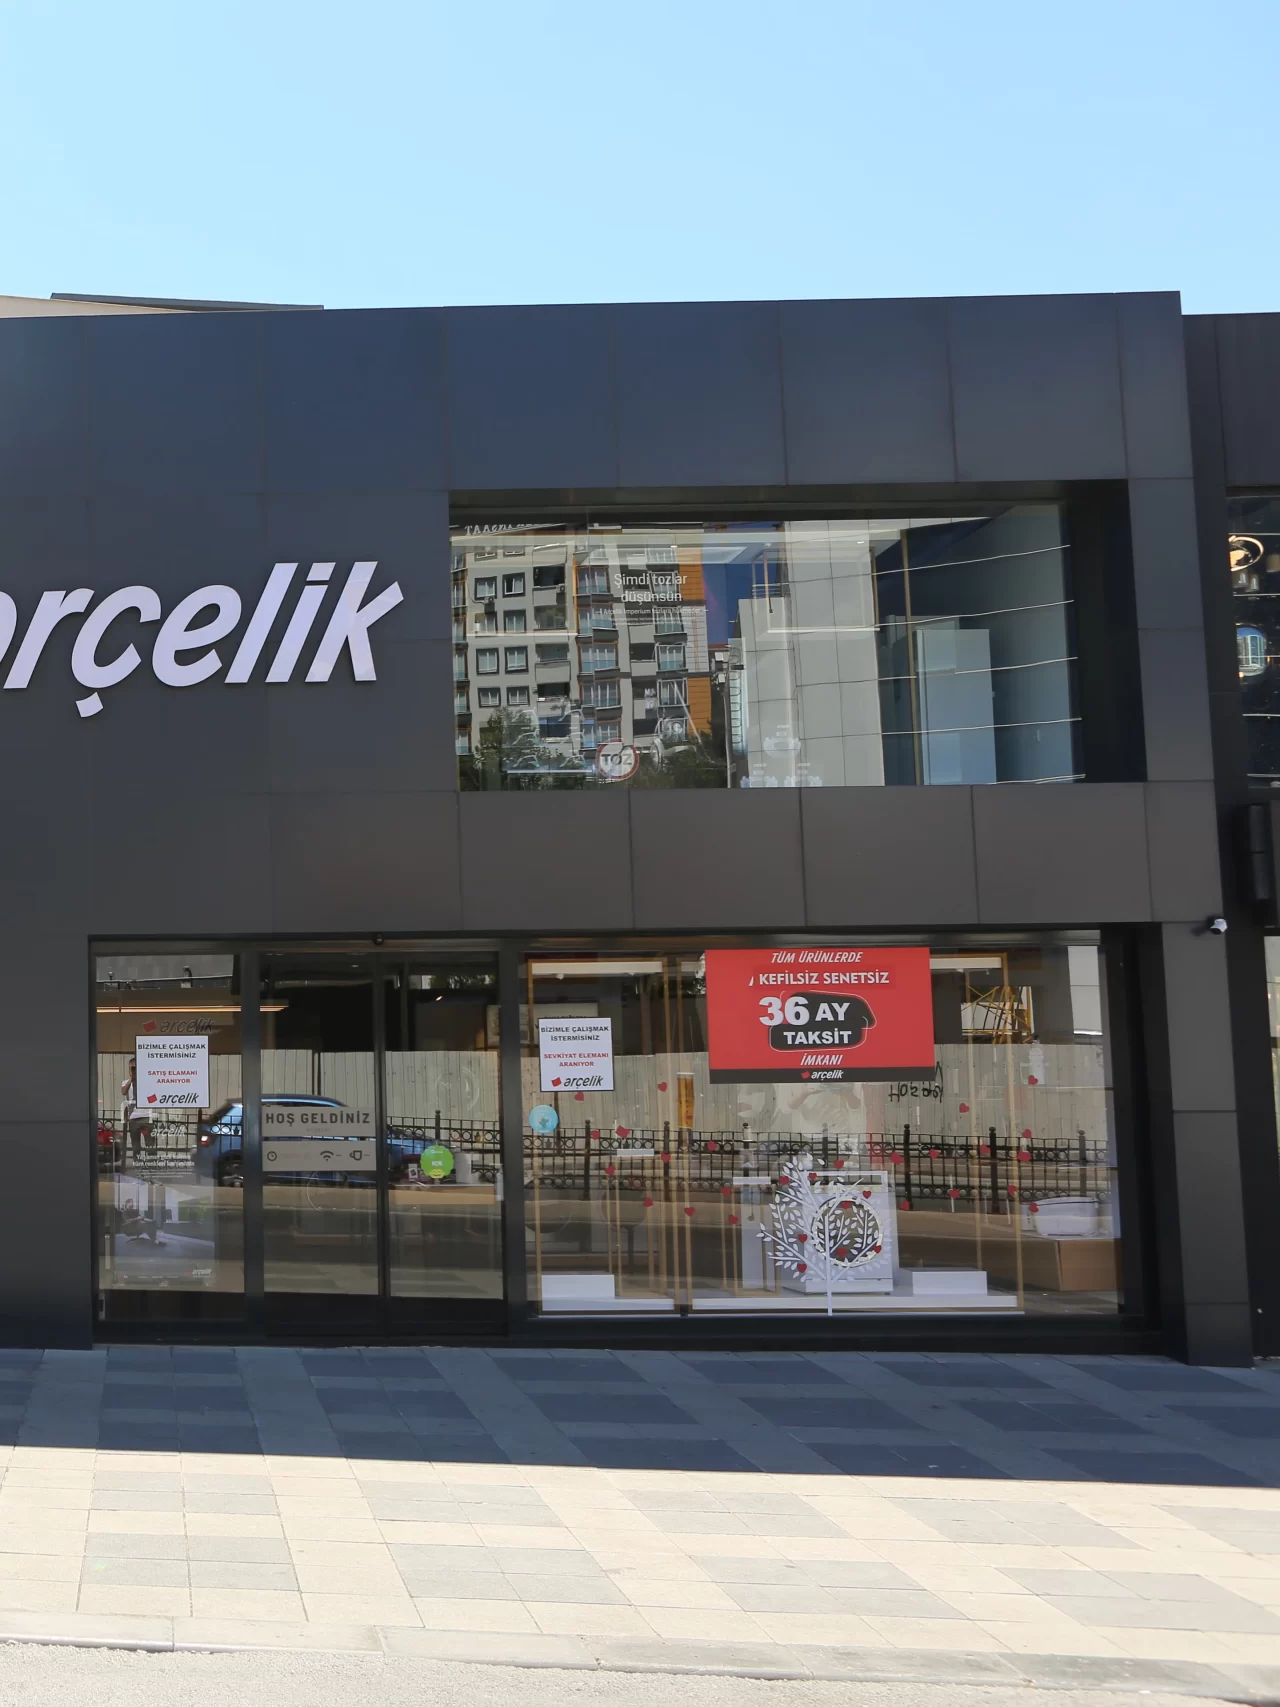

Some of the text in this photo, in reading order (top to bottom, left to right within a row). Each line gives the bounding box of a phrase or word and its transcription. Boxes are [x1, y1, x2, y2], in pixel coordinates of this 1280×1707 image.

[614, 572, 688, 589] Şimdi tozlar
[620, 590, 682, 606] düşünsün
[601, 754, 632, 766] TOZ
[771, 950, 863, 964] TÜM ÜRÜNLERDE
[759, 968, 890, 985] KEFİLSİZ SENETSİZ
[759, 996, 850, 1026] 36 AY
[783, 1028, 852, 1045] TAKSİT
[168, 1043, 206, 1051] ÇALIŞMAK
[800, 1053, 843, 1066] İMKANI
[811, 1069, 844, 1081] arçelik
[564, 1076, 603, 1089] arçelik
[160, 1093, 199, 1106] arçelik
[265, 1110, 370, 1128] HOŞ GELDİNİZ
